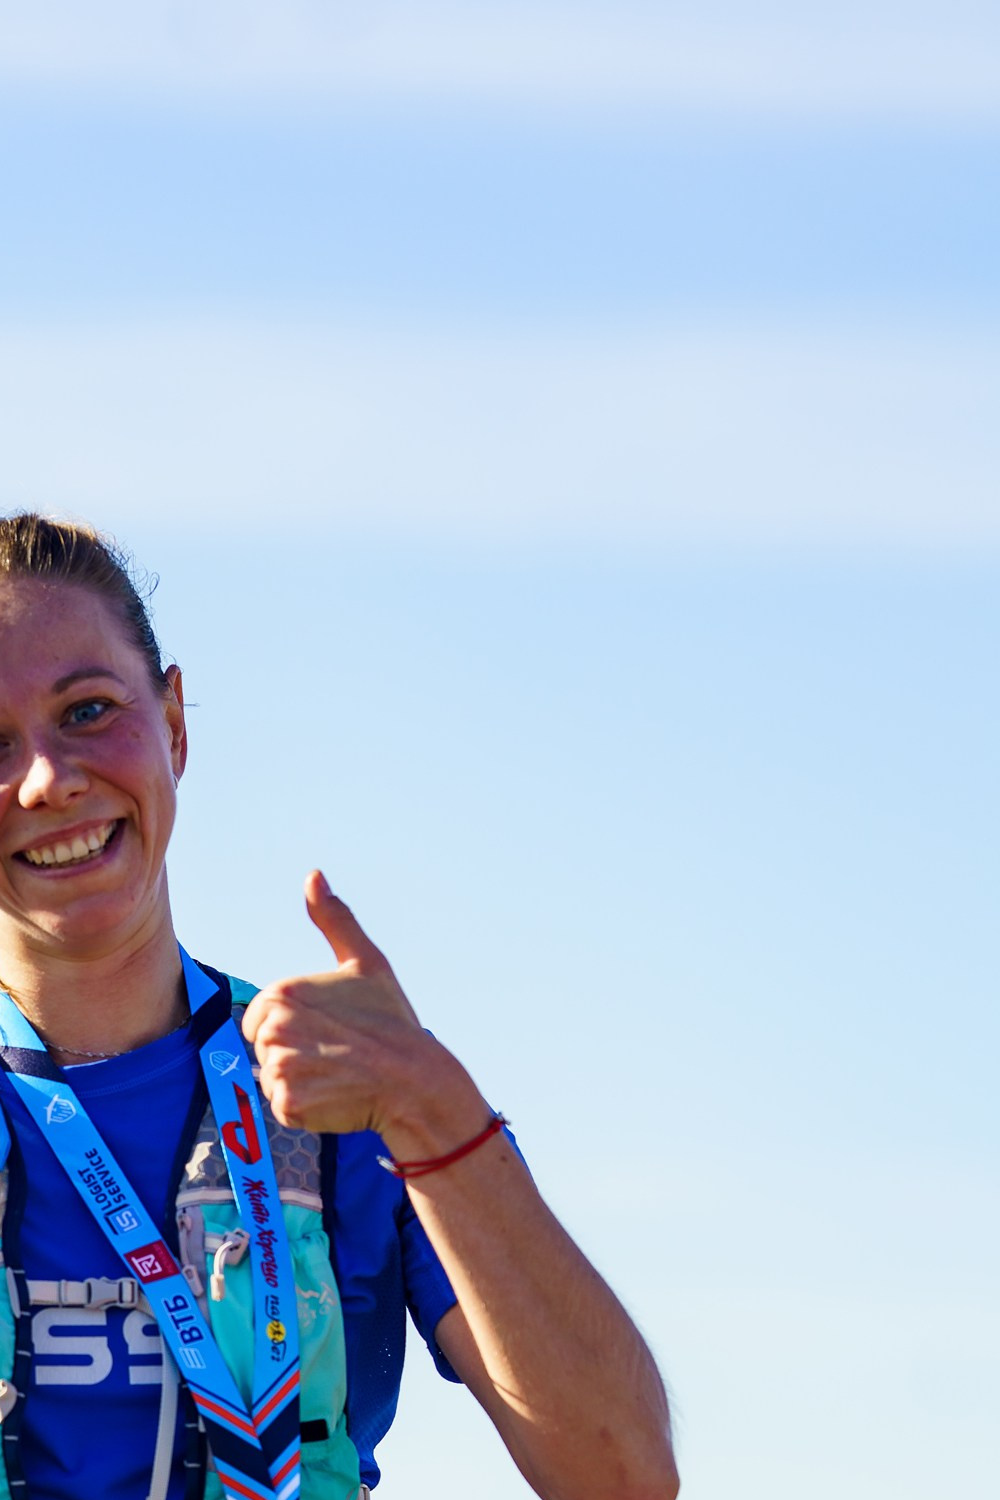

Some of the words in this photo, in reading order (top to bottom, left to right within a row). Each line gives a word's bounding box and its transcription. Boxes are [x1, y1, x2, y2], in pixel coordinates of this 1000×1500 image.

[77, 1169, 112, 1213] LOGIST
[84, 1147, 126, 1204] SERVICE
[242, 1175, 270, 1226] Жить
[258, 1225, 281, 1289] Хорошо
[163, 1294, 205, 1345] ВТБ
